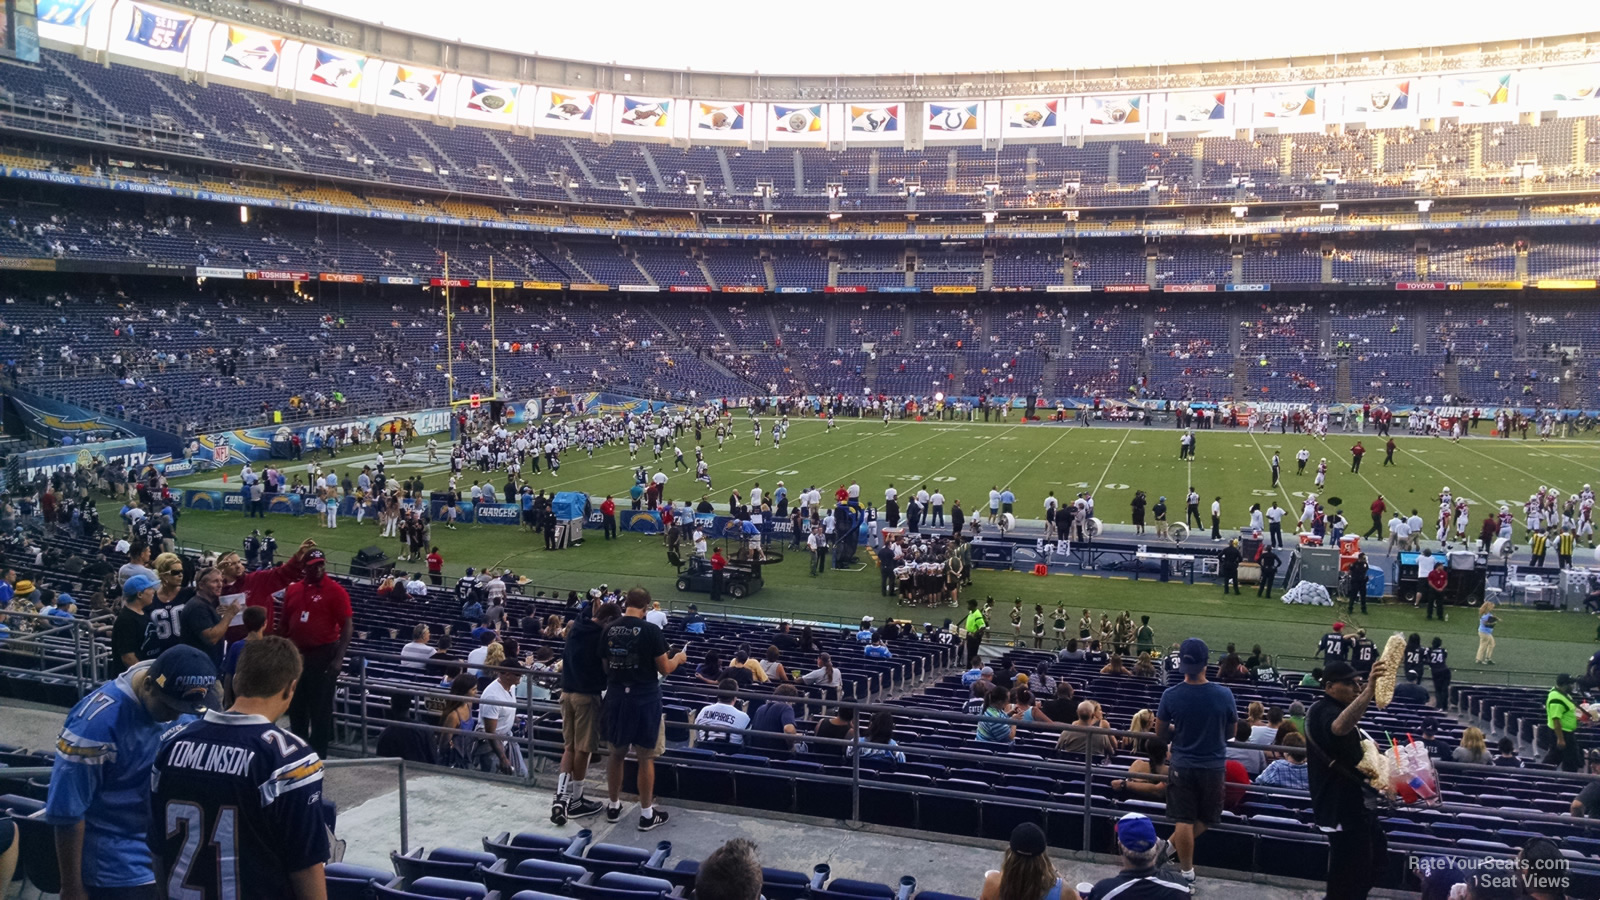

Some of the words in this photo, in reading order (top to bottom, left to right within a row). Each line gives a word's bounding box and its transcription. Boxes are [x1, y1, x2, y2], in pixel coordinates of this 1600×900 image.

[149, 27, 176, 49] 55
[29, 172, 48, 181] EMIL
[49, 174, 76, 184] KARAS
[129, 184, 145, 192] BOB
[145, 186, 173, 195] LARABA
[1518, 219, 1566, 227] WASHINGTON
[260, 271, 291, 279] TOSHIBA
[215, 446, 229, 460] NFL
[478, 507, 518, 518] CHARGERS
[1036, 566, 1046, 575] 40
[1327, 640, 1341, 655] 24
[1360, 647, 1371, 660] 16
[1407, 652, 1420, 664] 24
[1430, 653, 1443, 663] 24
[78, 692, 115, 721] 17
[702, 710, 736, 725] HUMPHRIES
[261, 729, 309, 758] 21
[168, 740, 256, 777] TOMLINSON
[165, 799, 240, 899] 21
